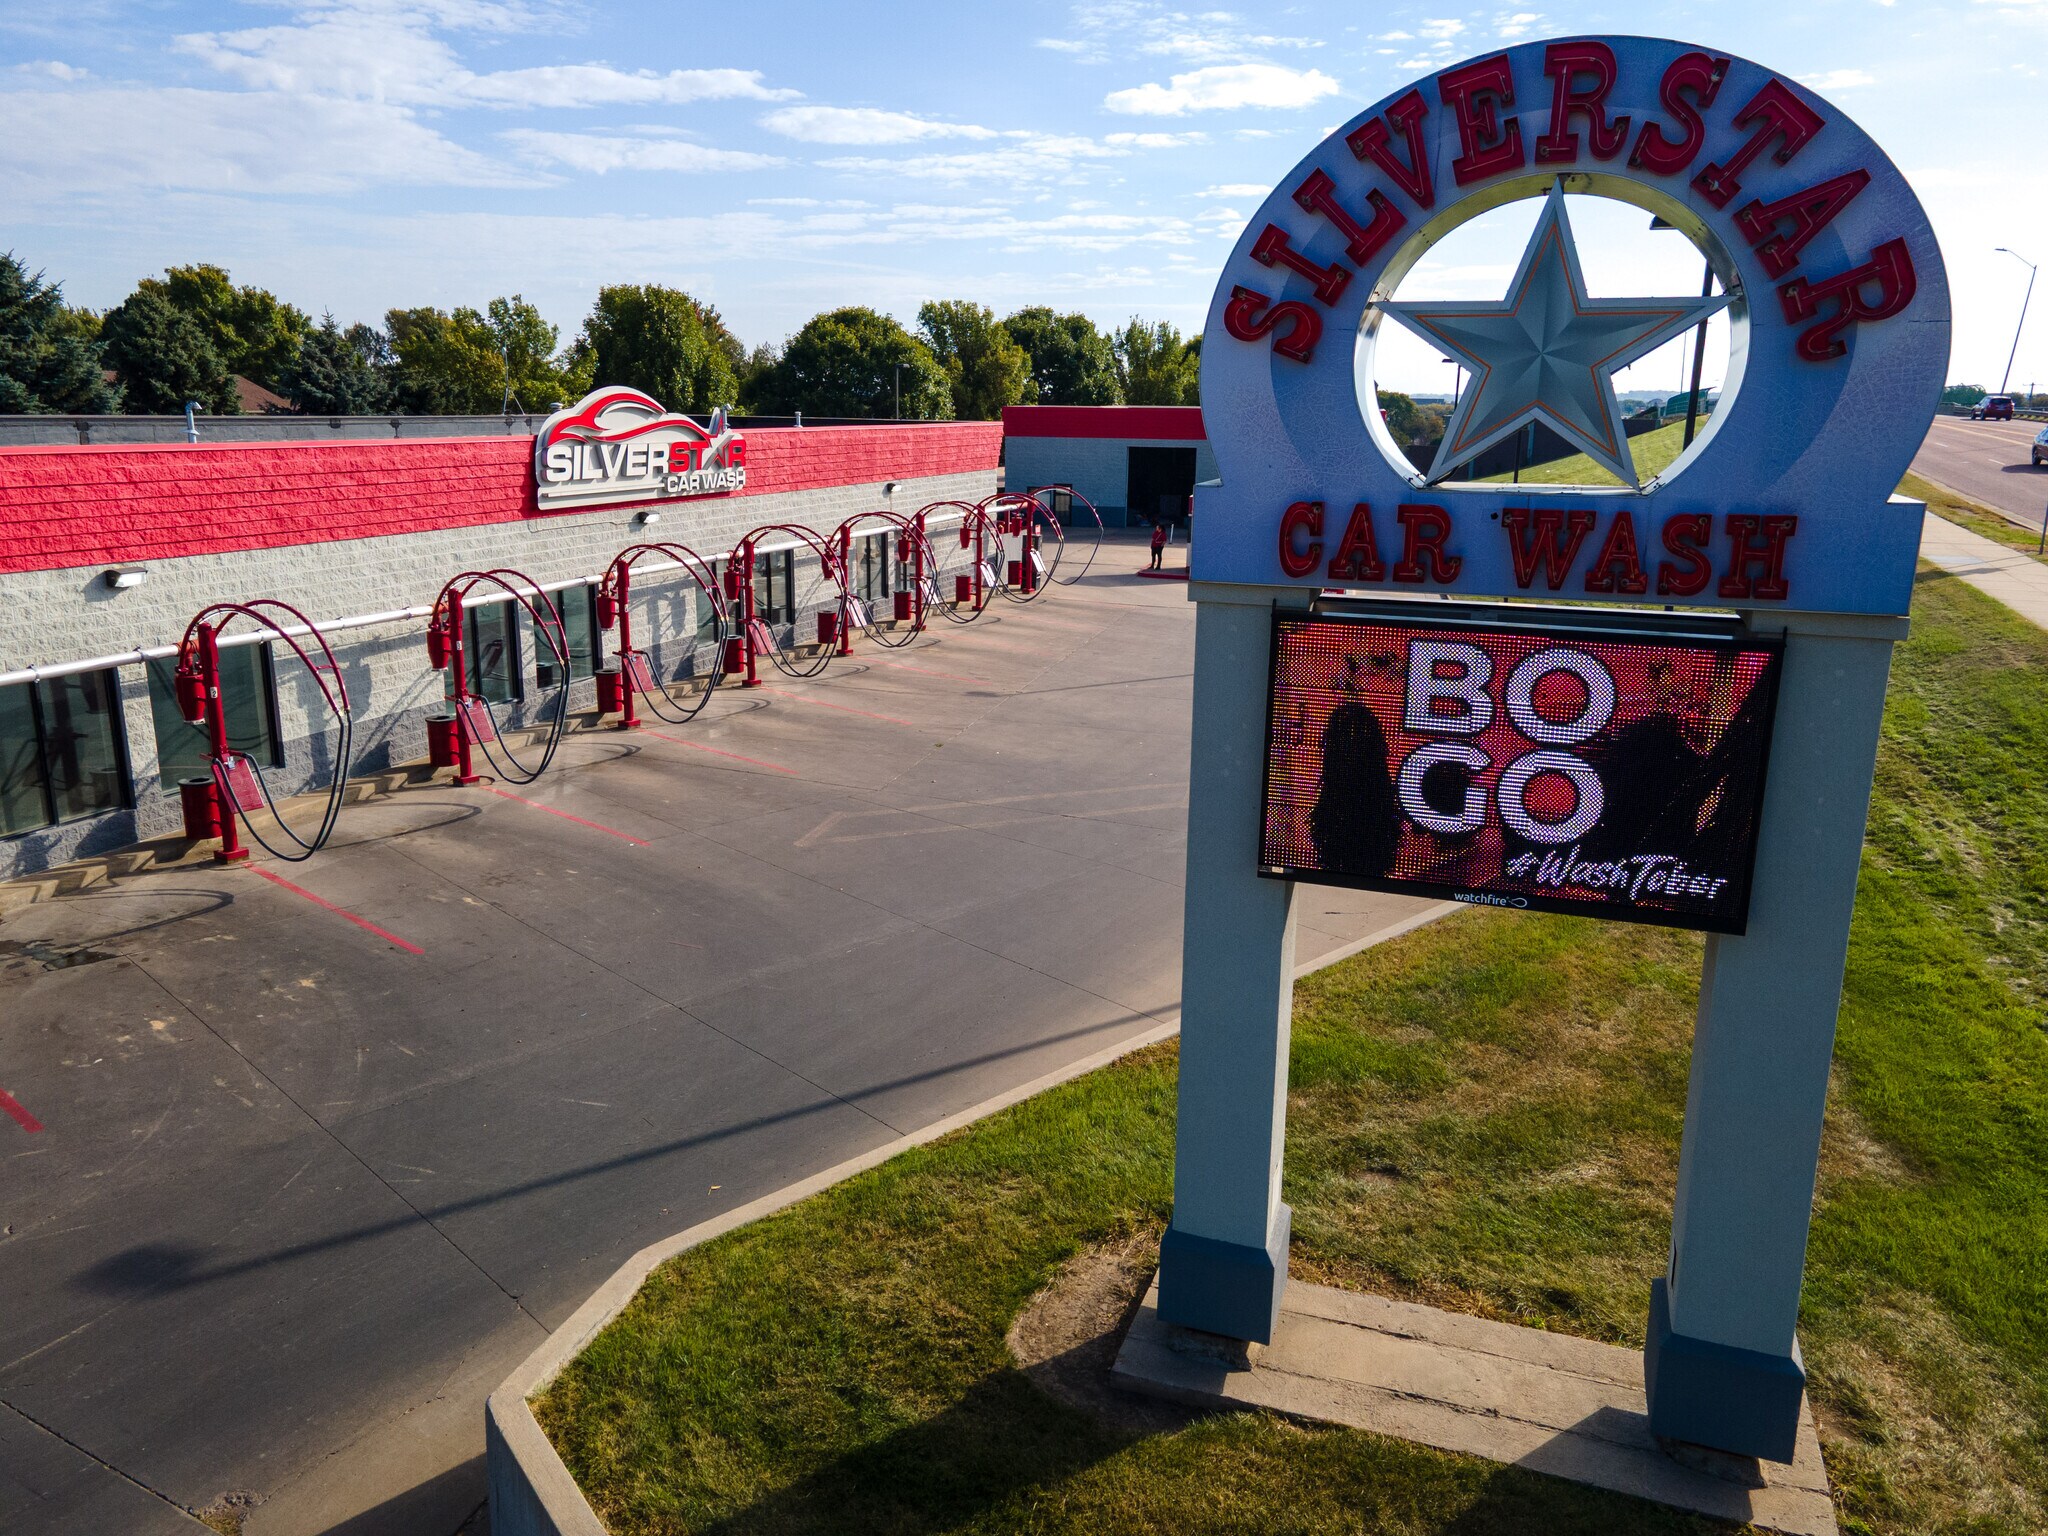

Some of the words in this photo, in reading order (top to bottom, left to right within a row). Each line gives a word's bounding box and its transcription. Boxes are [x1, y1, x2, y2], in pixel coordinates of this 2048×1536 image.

[1223, 41, 1917, 364] SILVERSTAR
[667, 474, 700, 493] CAR
[703, 468, 746, 489] WASH
[1278, 501, 1462, 584] CAR
[1501, 506, 1798, 601] WASH
[1403, 638, 1616, 744] BO
[1399, 741, 1604, 844] GO
[1454, 892, 1507, 906] watchfire
